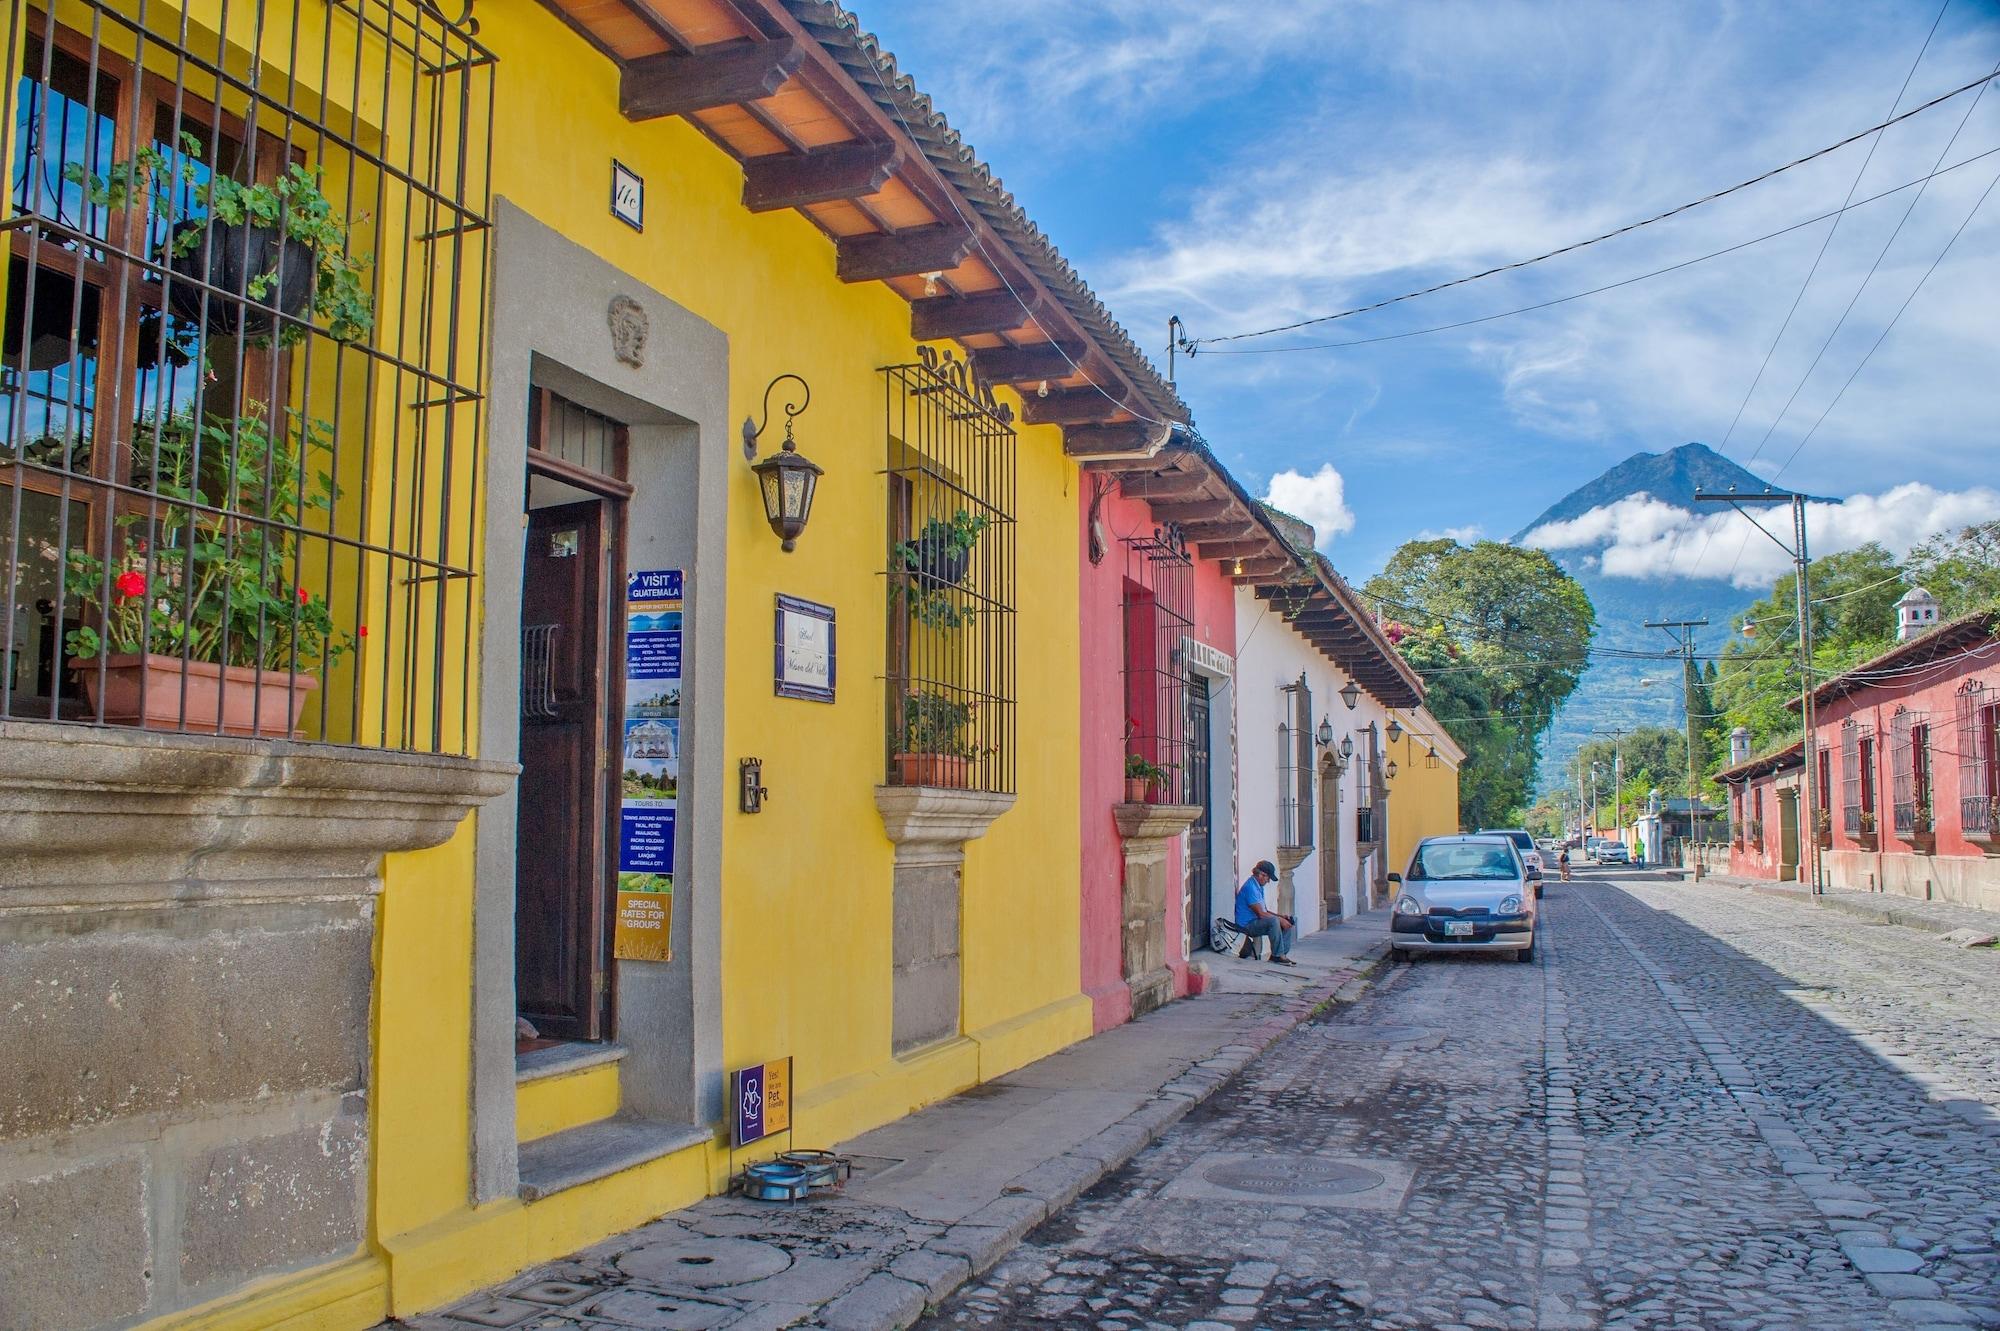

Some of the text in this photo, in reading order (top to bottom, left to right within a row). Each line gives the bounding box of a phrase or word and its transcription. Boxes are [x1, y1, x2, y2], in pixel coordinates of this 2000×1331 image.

[642, 574, 670, 587] VISIT
[633, 588, 679, 597] GUATEMALA
[628, 899, 661, 909] SPECIAL
[621, 909, 665, 919] RATES FOR
[627, 920, 661, 929] GROUPS
[768, 1091, 780, 1101] Pet
